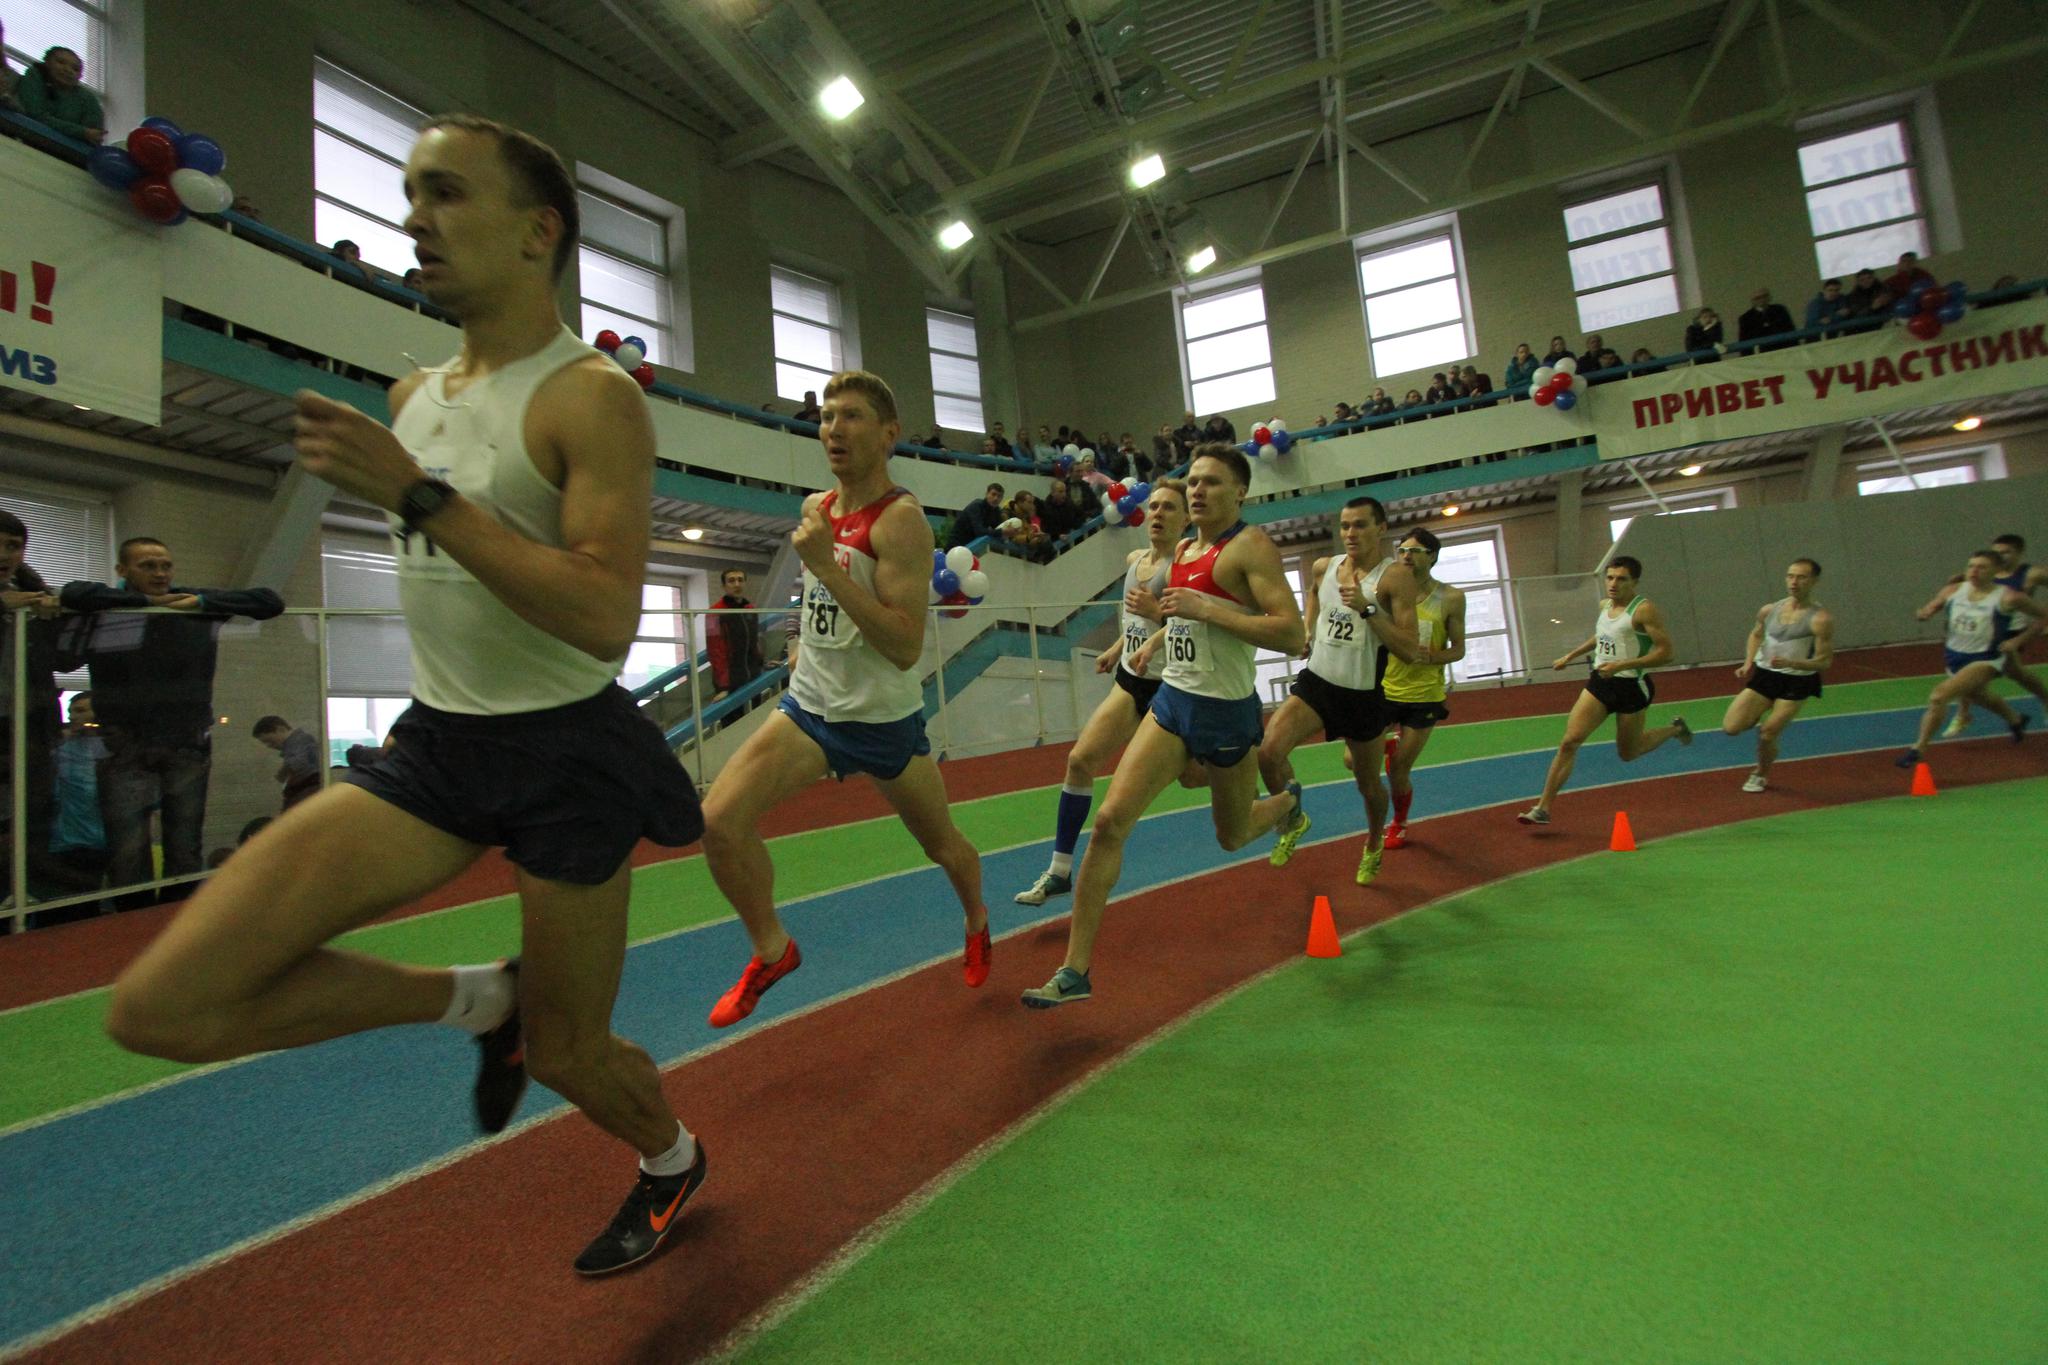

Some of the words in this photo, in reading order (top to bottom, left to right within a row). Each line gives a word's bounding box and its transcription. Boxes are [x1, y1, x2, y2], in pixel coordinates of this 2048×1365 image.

[1633, 374, 1786, 429] ПРИВЕТ
[1806, 324, 2048, 400] УЧАСТНИК
[808, 602, 839, 637] 787
[1328, 620, 1354, 641] 722
[1126, 634, 1148, 653] 70
[1168, 636, 1196, 662] 760
[1600, 640, 1616, 656] 791
